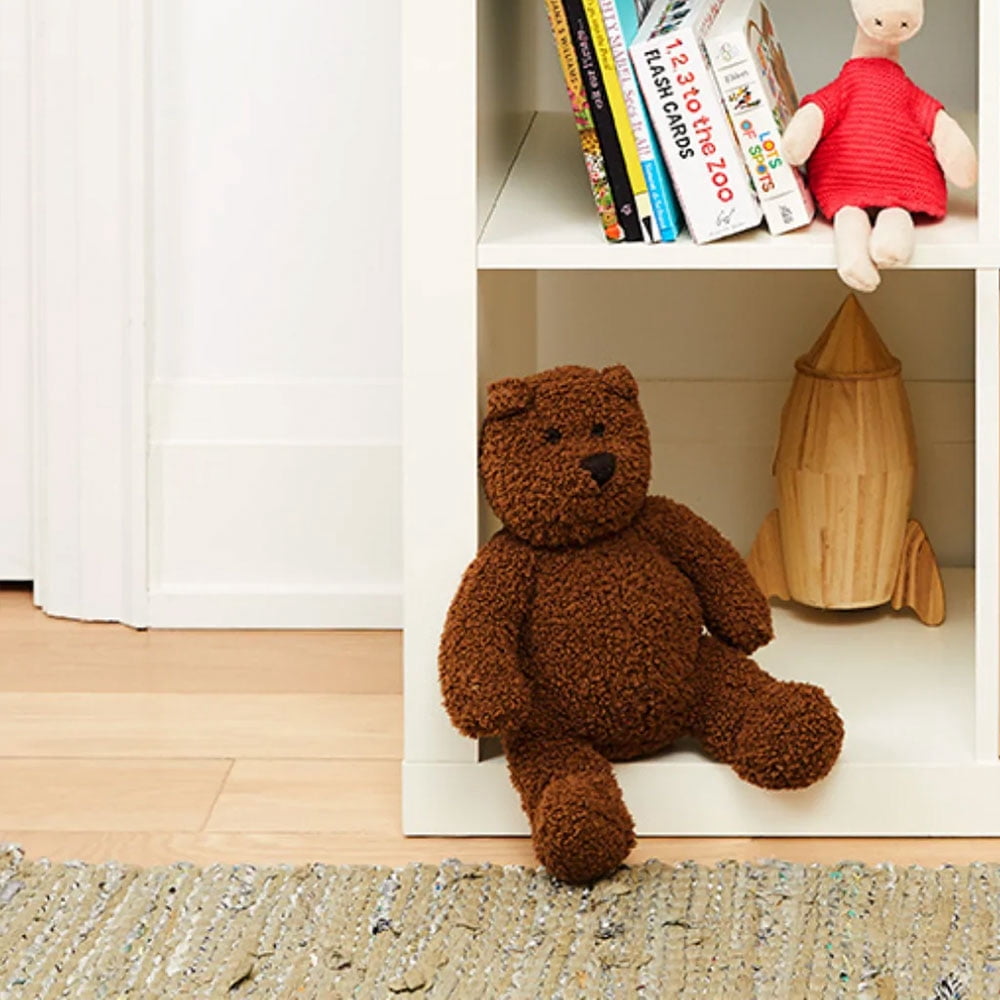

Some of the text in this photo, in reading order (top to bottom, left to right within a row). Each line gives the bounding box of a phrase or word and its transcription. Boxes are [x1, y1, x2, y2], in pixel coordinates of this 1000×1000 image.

[560, 35, 578, 85] WILLIAMS
[611, 35, 632, 82] MABEL
[644, 48, 694, 159] FLASH CARDS
[683, 86, 702, 113] to
[693, 116, 716, 156] the
[705, 158, 734, 203] Zoo
[740, 120, 776, 193] OF SPOTS
[759, 130, 783, 169] LOTS
